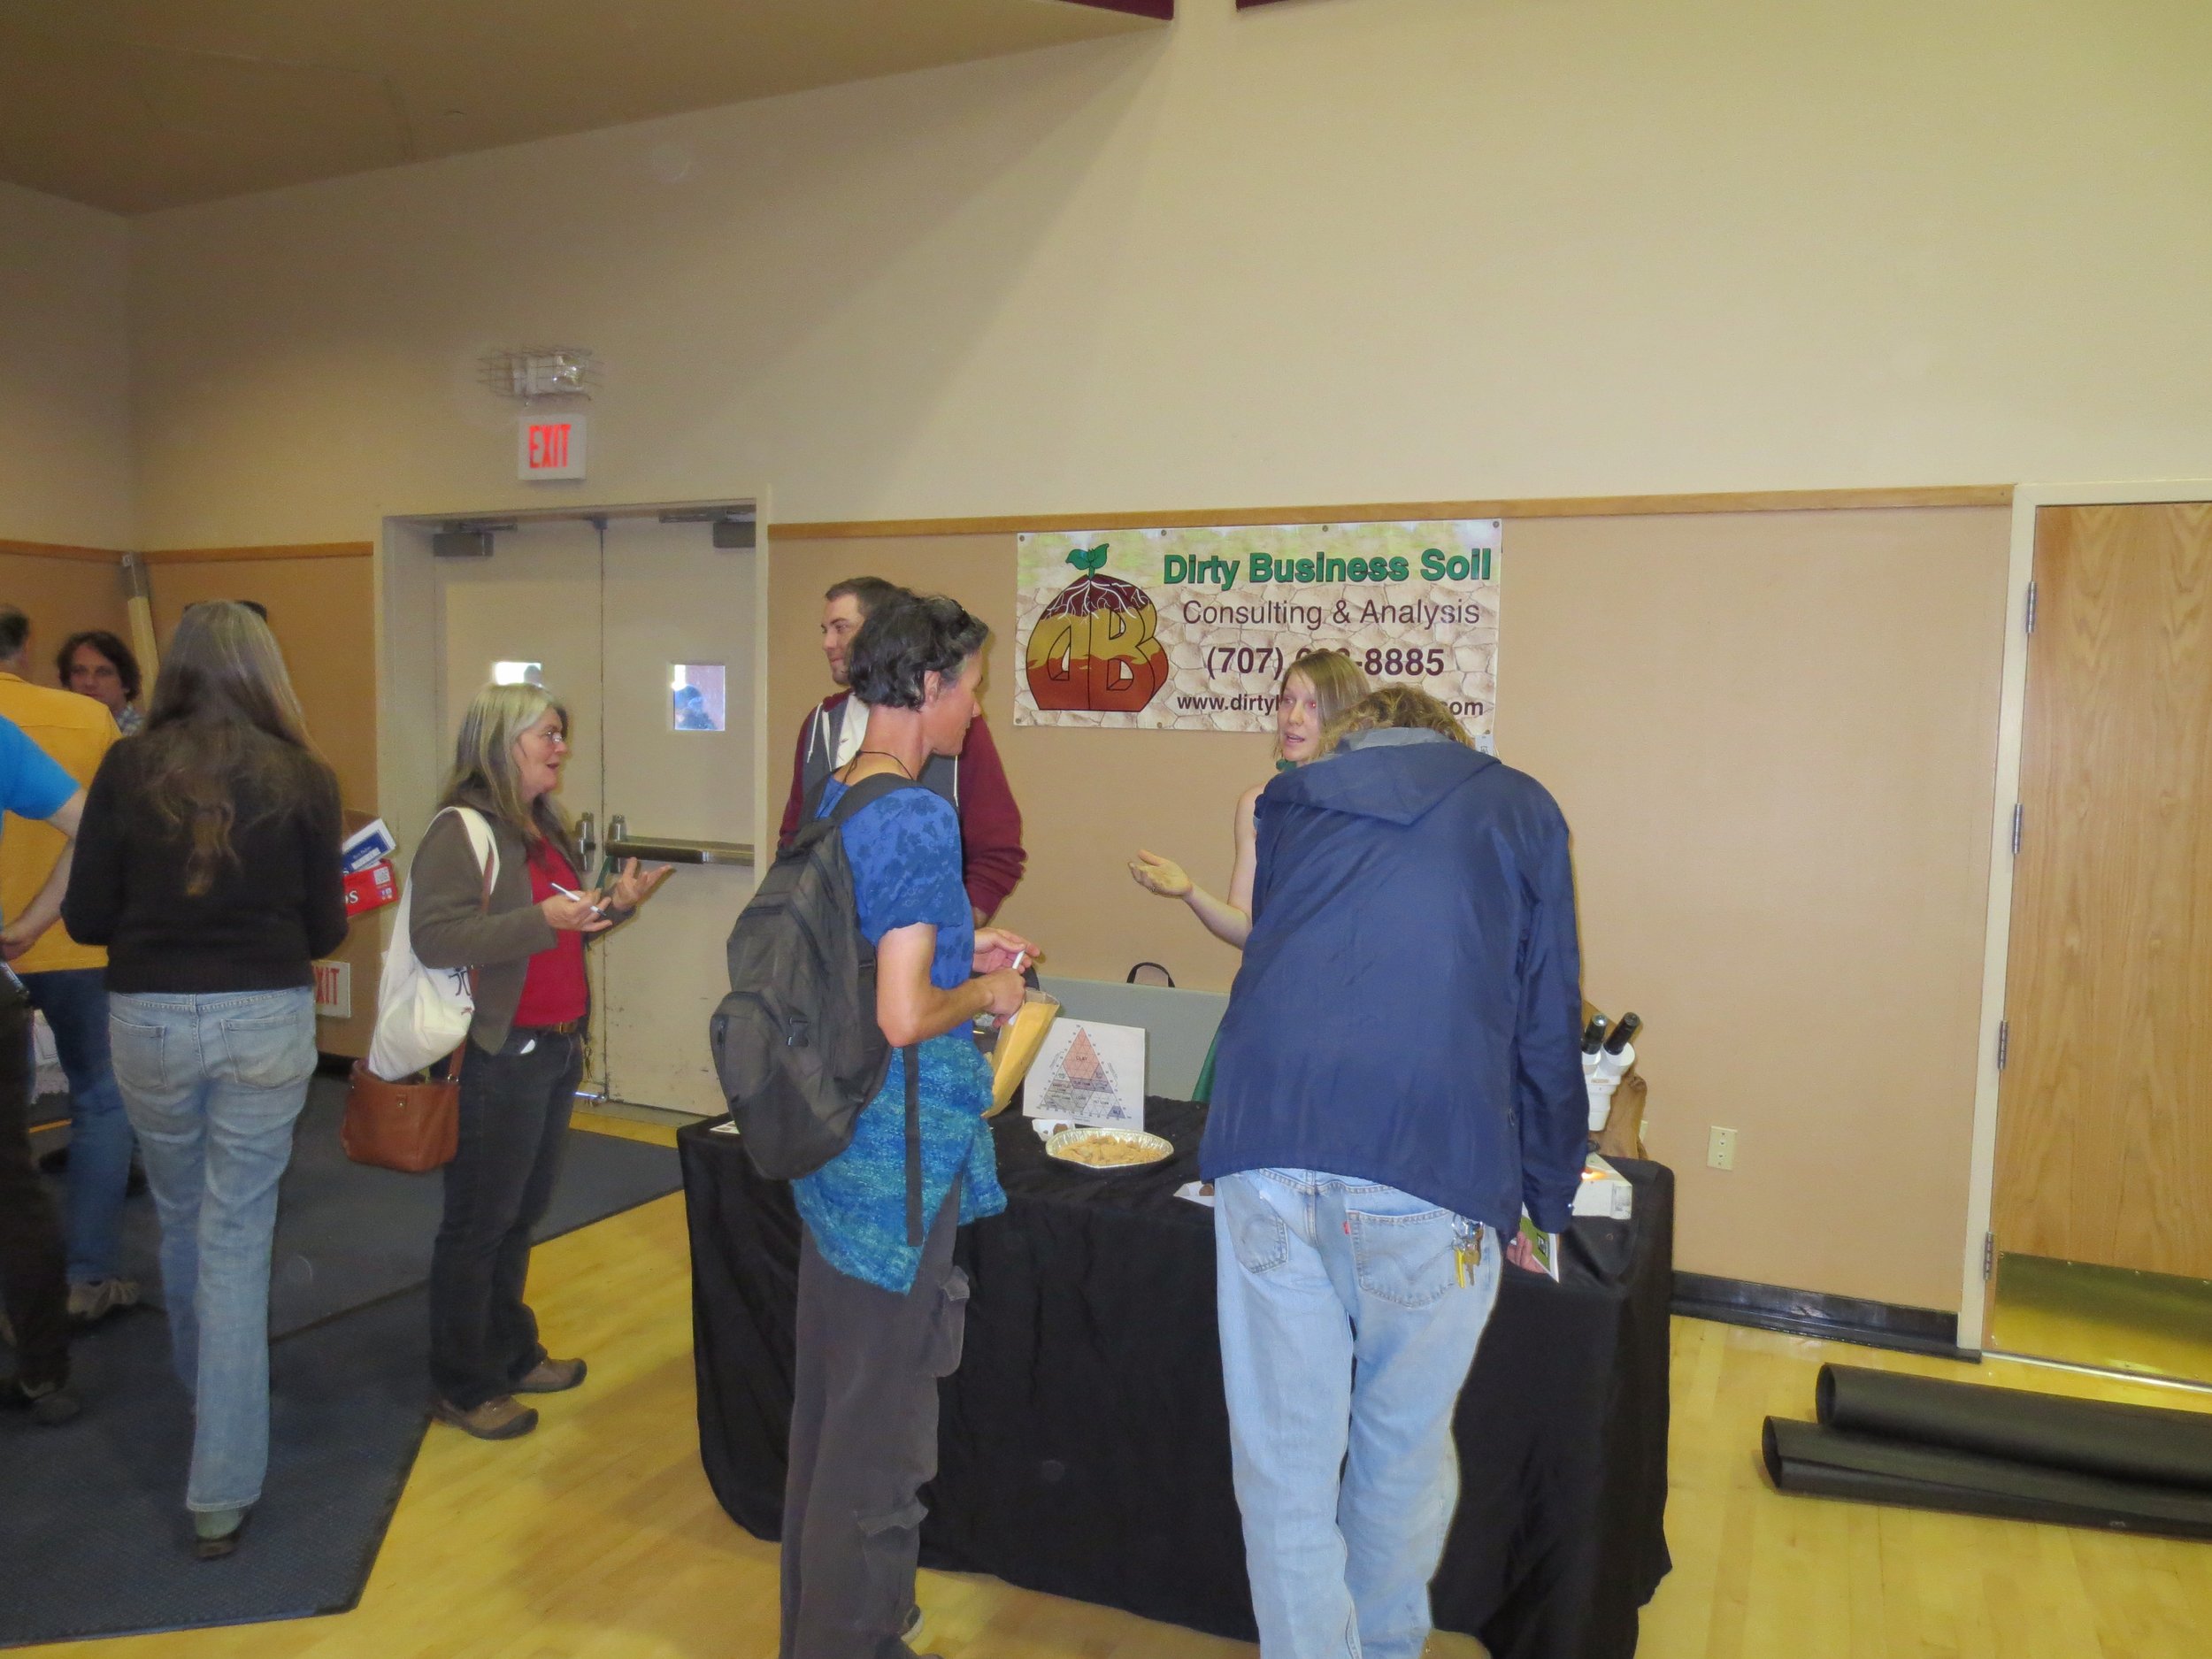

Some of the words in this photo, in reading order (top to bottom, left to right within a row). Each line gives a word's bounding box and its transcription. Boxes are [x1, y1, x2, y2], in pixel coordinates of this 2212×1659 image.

[528, 424, 572, 469] EXIT
[1164, 553, 1240, 592] Dirty
[1249, 551, 1409, 584] Business
[1420, 548, 1492, 582] Soil
[1183, 599, 1322, 630] Consulting
[1333, 599, 1352, 624] &
[1360, 598, 1480, 630] Analysis
[1207, 647, 1284, 680] (707)
[1295, 647, 1445, 677] -8885
[311, 965, 341, 1006] XIT
